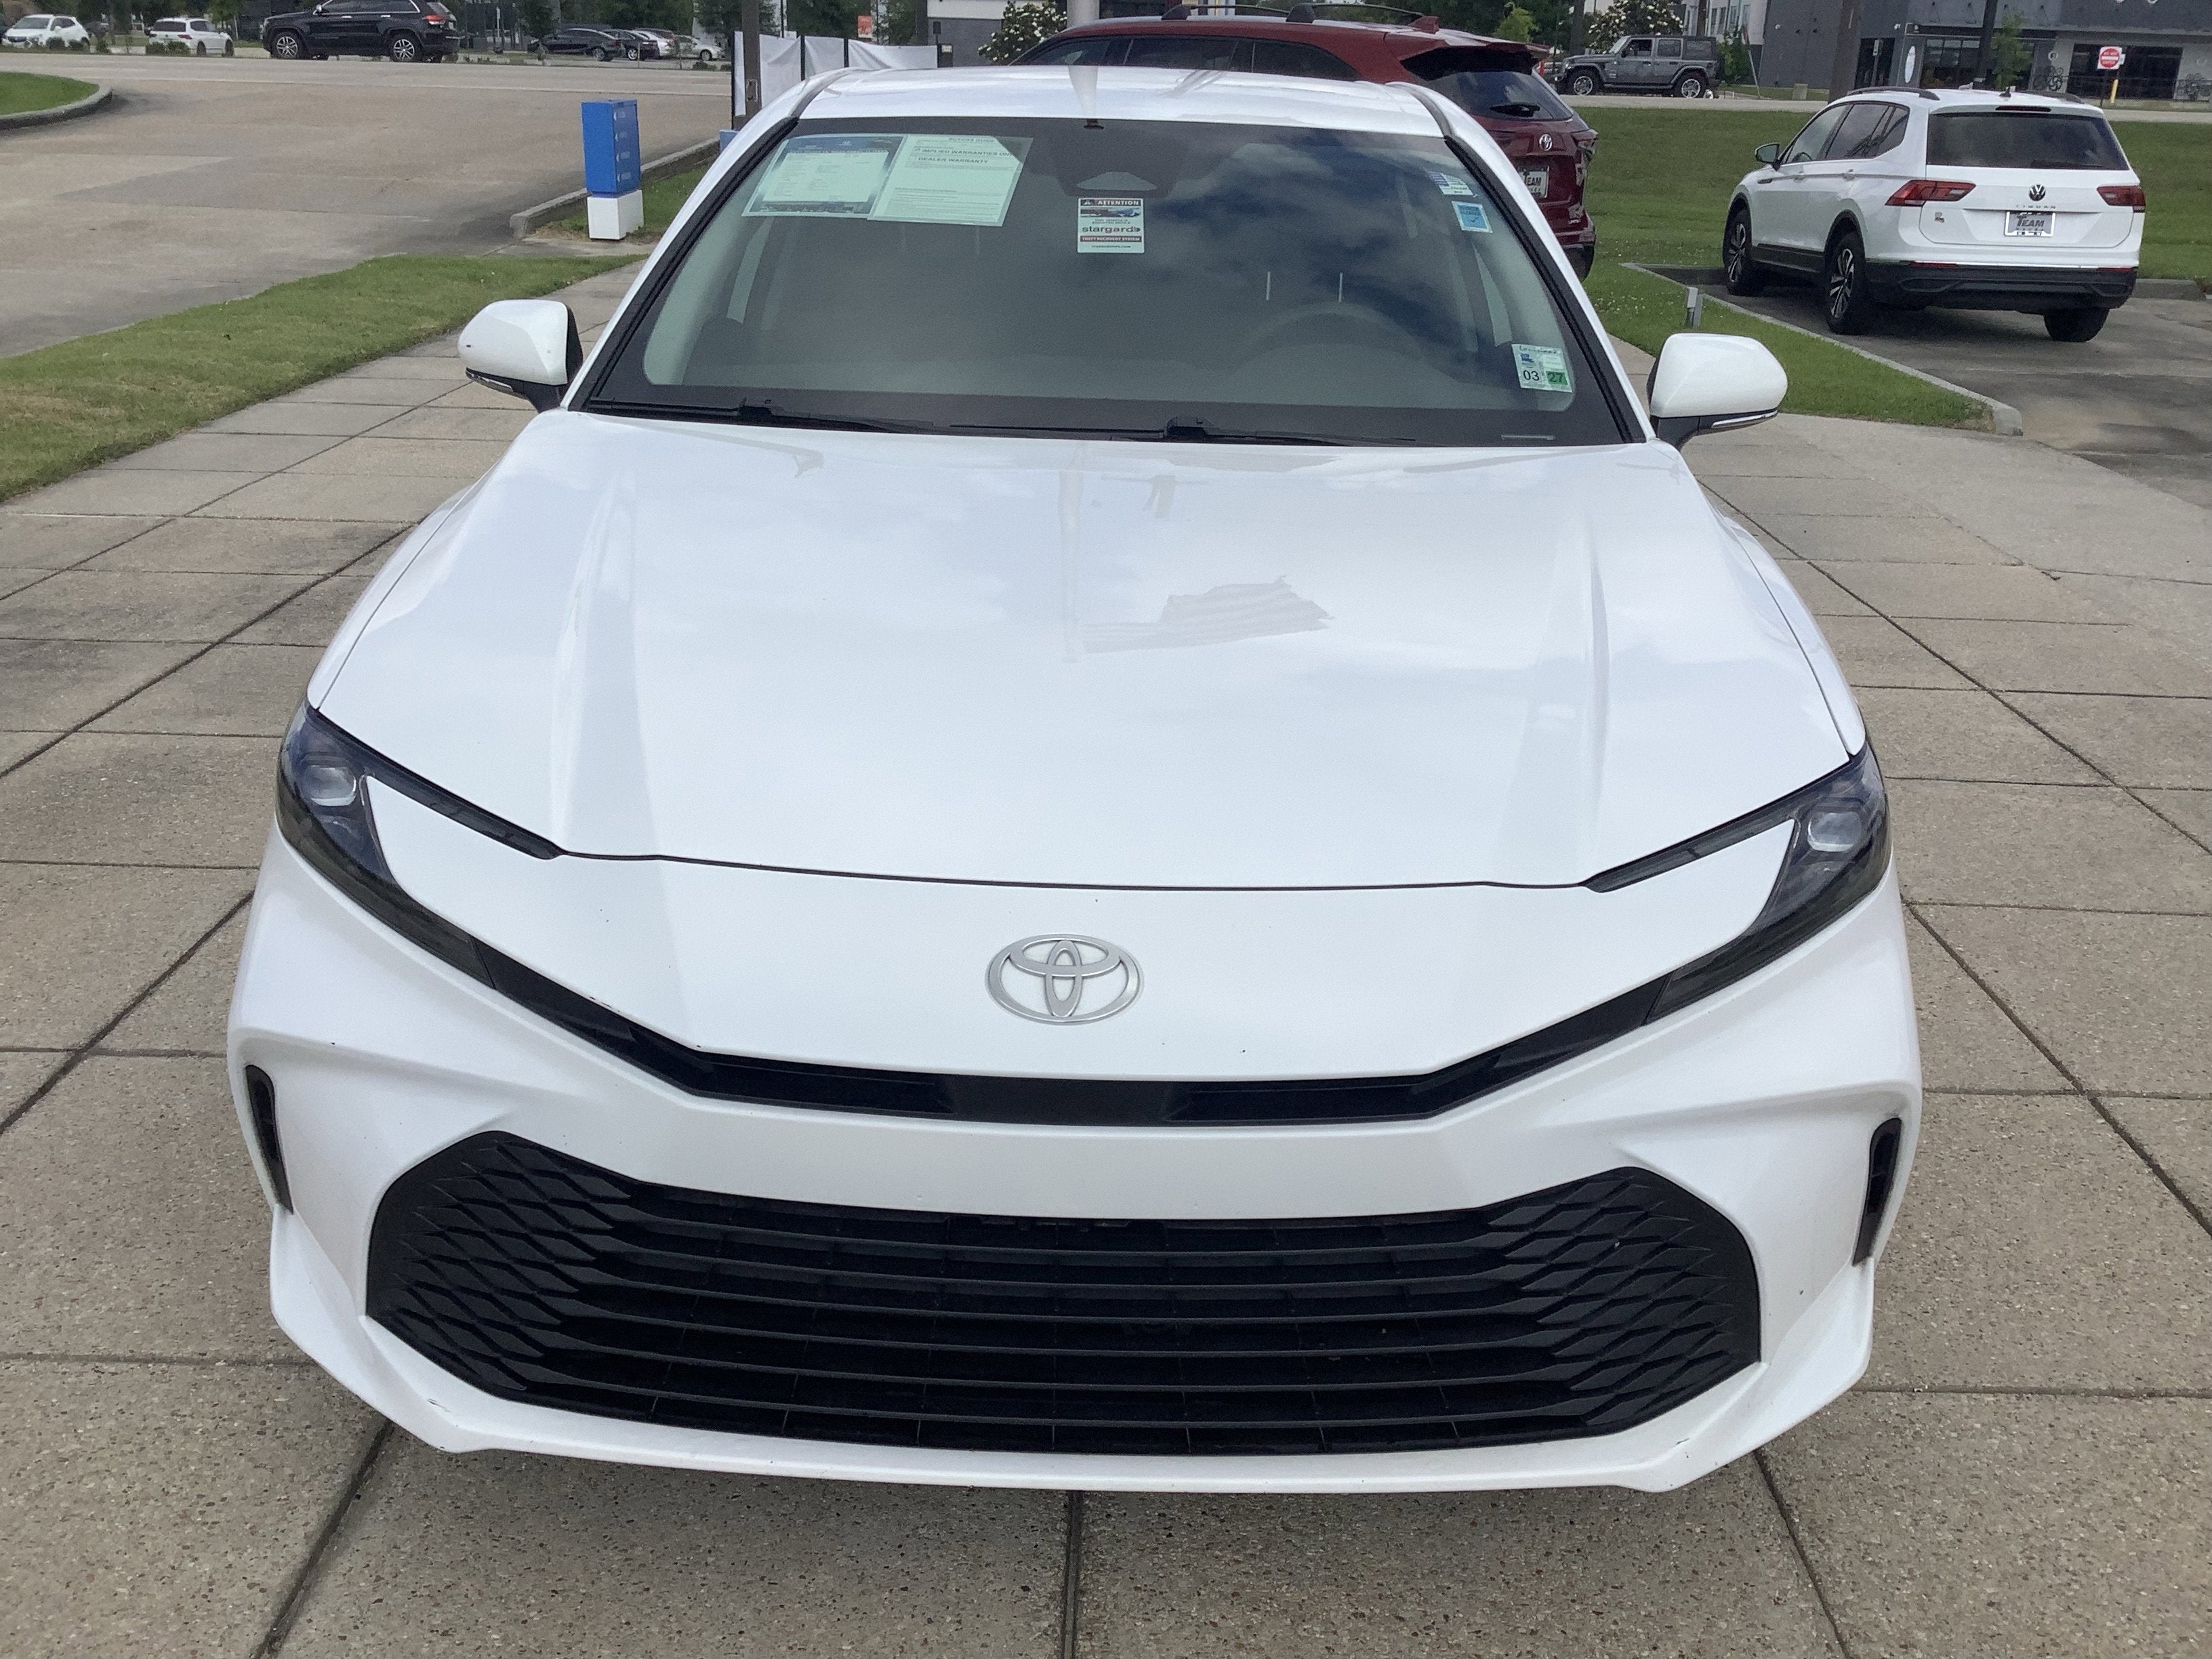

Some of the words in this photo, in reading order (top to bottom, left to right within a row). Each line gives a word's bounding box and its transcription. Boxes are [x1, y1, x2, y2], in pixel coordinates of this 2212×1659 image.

[2016, 215, 2045, 227] TEAM
[1523, 369, 1540, 381] 03
[1547, 371, 1563, 382] 27
